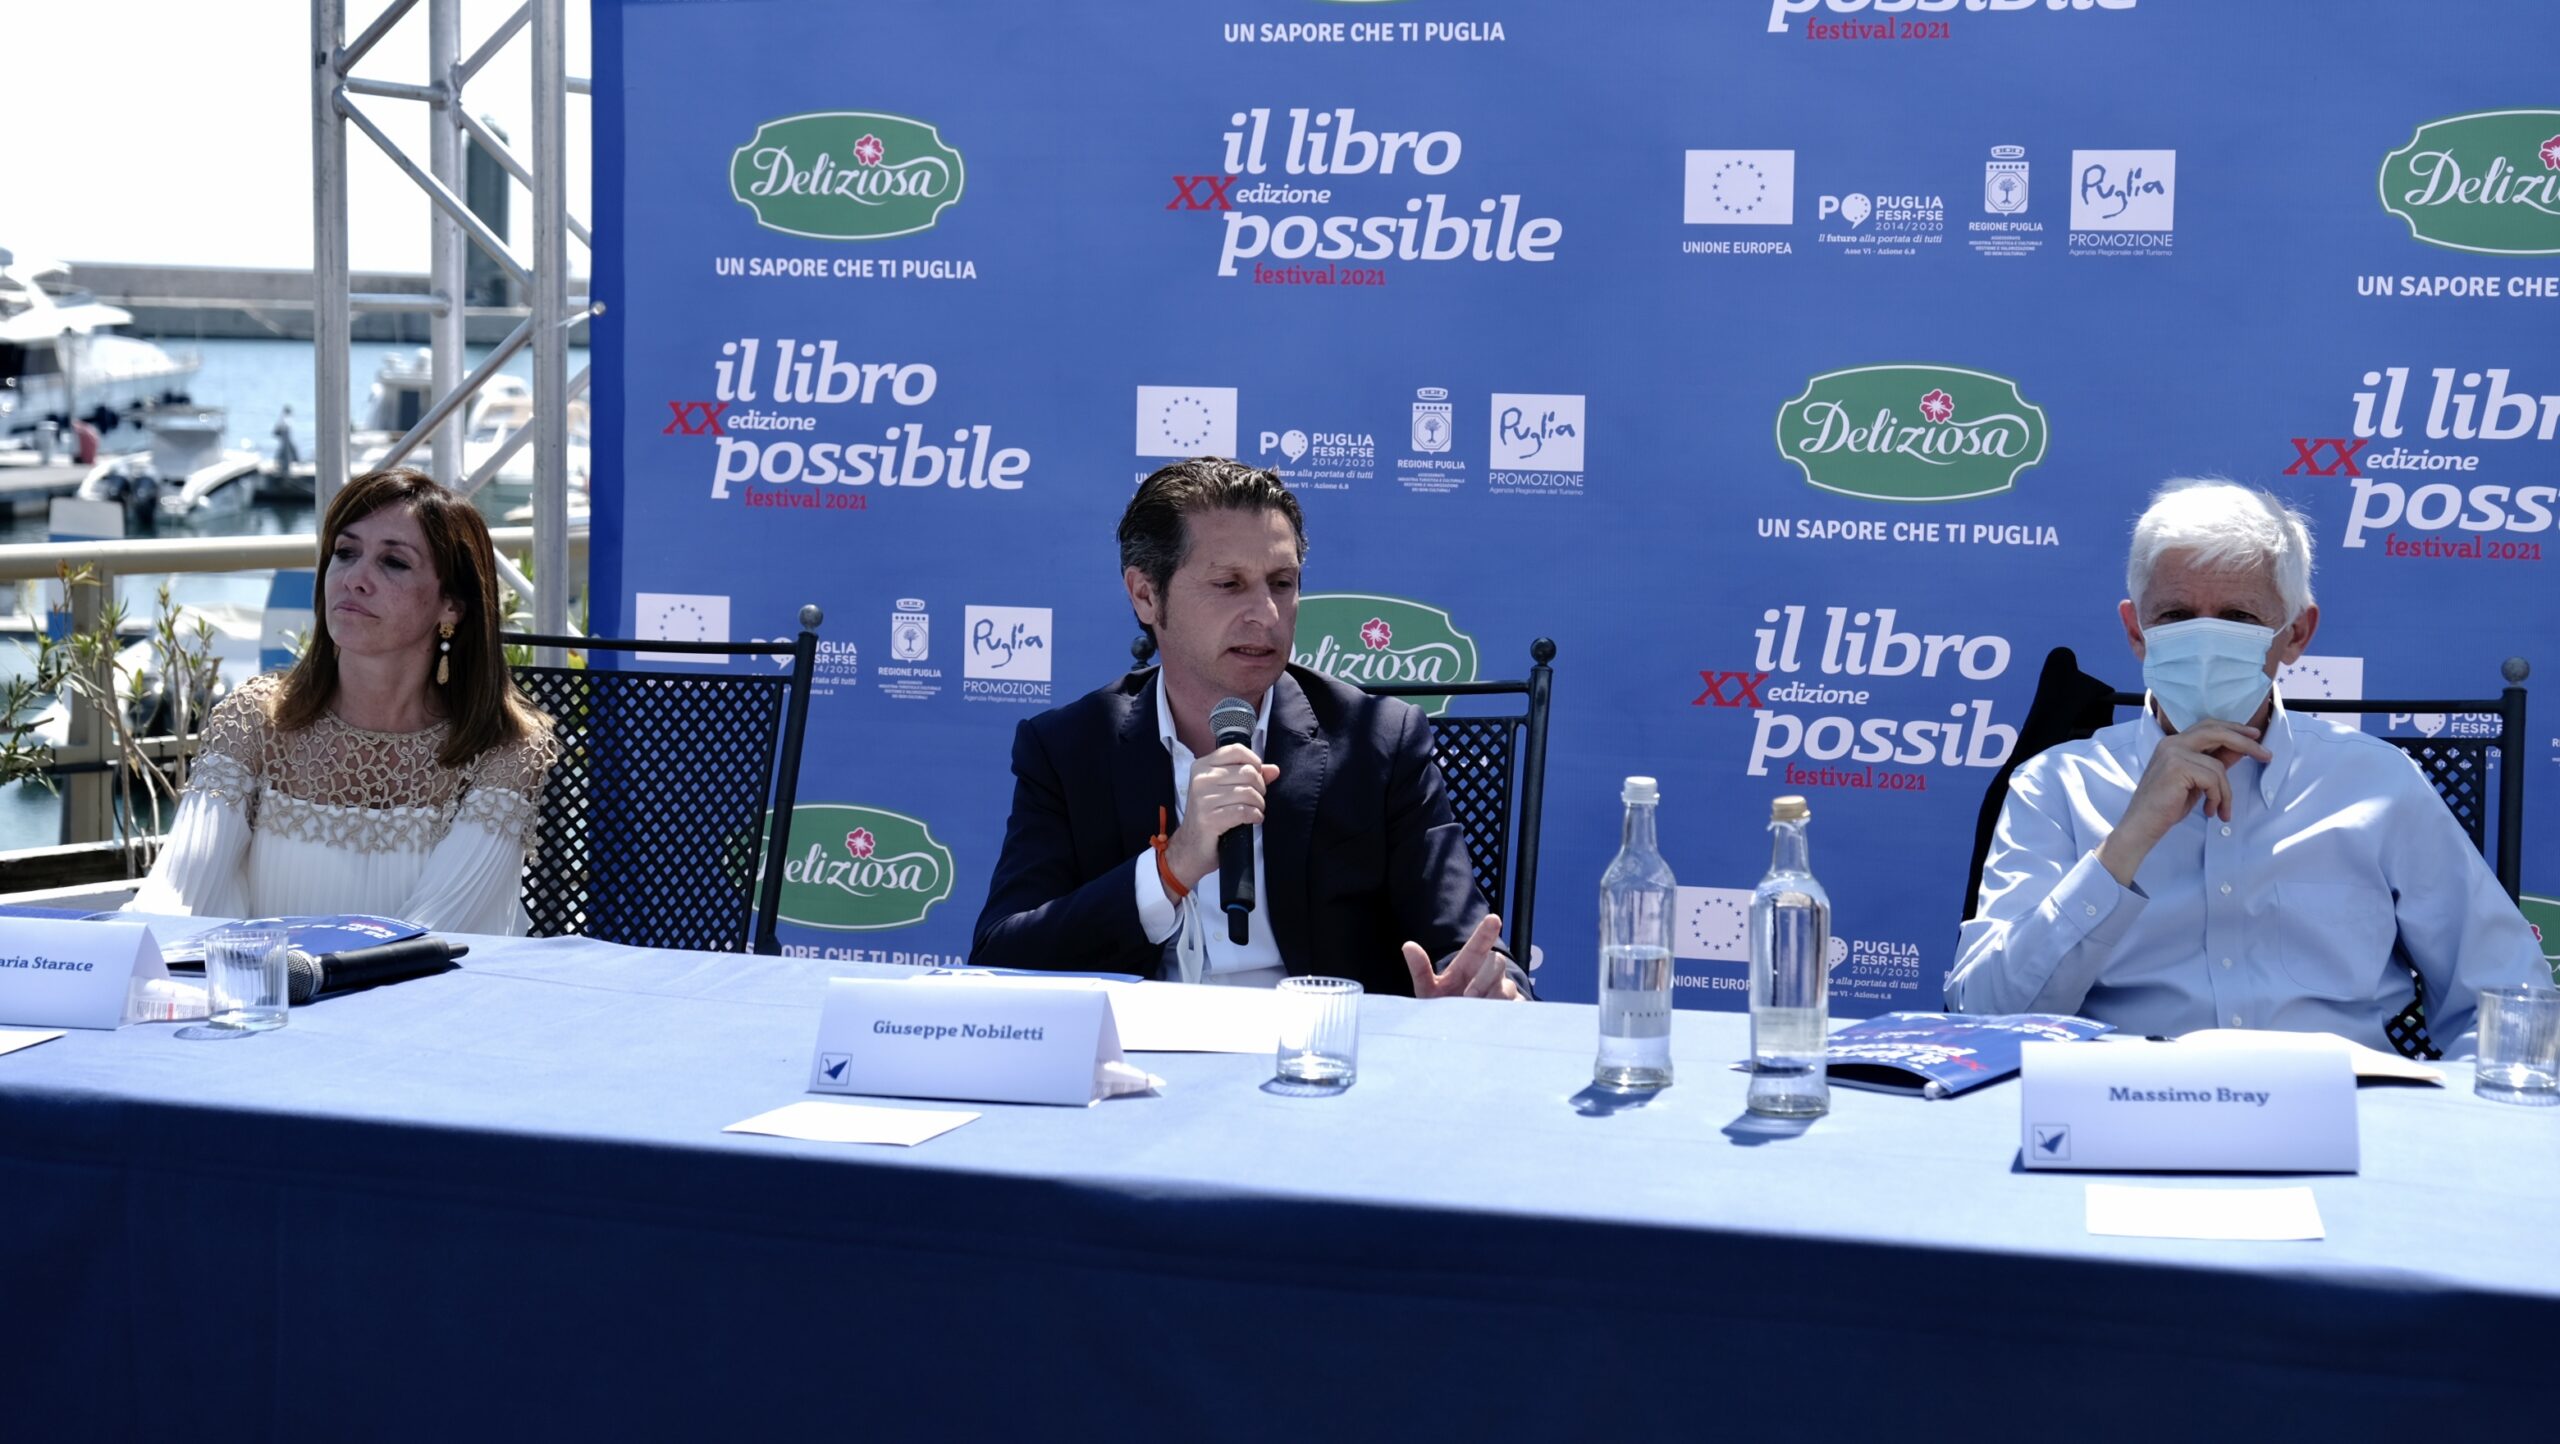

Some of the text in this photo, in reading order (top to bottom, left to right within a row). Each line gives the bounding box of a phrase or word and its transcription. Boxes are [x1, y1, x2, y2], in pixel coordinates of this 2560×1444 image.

[1224, 22, 1505, 42] UN SAPORE CHE TI PUGLIA
[1807, 17, 1950, 39] festival 2021
[1223, 108, 1462, 175] il libro
[751, 146, 949, 205] Deliziosa
[1166, 176, 1331, 210] XX edizione
[1876, 196, 1943, 209] PUGLIA
[2081, 164, 2164, 219] Puglia
[1218, 194, 1562, 276] possibile
[1875, 222, 1943, 231] 2014/2020
[1969, 222, 2043, 231] REGIONE PUGLIA
[1683, 242, 1792, 254] UNIONE EUROPEA
[1827, 234, 1857, 242] futuro
[1859, 234, 1876, 243] alla
[1876, 235, 1910, 245] portata
[1912, 234, 1922, 243] di
[1924, 234, 1942, 243] tutti
[2068, 233, 2173, 246] PROMOZIONE
[716, 257, 977, 279] UN SAPORE CHE TI PUGLIA
[1254, 263, 1385, 286] festival 2021
[2357, 276, 2559, 297] UN SAPORE CHE
[715, 338, 937, 406] il libro
[2353, 367, 2409, 438] il
[662, 401, 816, 436] XX edizione
[1312, 433, 1374, 446] PUGLIA
[1500, 407, 1575, 459] Puglia
[1799, 399, 2029, 465] Deliziosa
[711, 423, 1031, 499] possibile
[1312, 458, 1374, 467] 2014/2020
[1397, 459, 1466, 470] REGIONE PUGLIA
[2282, 438, 2479, 477] XX edizione
[1297, 469, 1312, 478] alla
[1314, 470, 1344, 479] portata
[1346, 469, 1355, 478] di
[1357, 470, 1374, 479] tutti
[1489, 472, 1584, 487] PROMOZIONE
[744, 486, 867, 510] festival 2021
[2343, 478, 2560, 548] poss
[1757, 518, 2059, 546] UN SAPORE CHE TI PUGLIA
[2385, 533, 2541, 560] festival 2021
[973, 618, 1043, 668] Puglia
[1755, 605, 2011, 680] il libro
[1292, 635, 1461, 684] eliziosa
[878, 667, 942, 678] REGIONE PUGLIA
[963, 681, 1051, 696] PROMOZIONE
[1691, 671, 1869, 709] XX edizione
[1785, 762, 1926, 791] festival 2021
[757, 836, 939, 897] eliziosa
[1853, 940, 1919, 956] PUGLIA
[32, 956, 93, 972] Starace
[1852, 966, 1919, 978] 2014/2020
[1836, 977, 1852, 985] alla
[1854, 978, 1886, 988] portata
[1889, 979, 1898, 988] di
[1900, 980, 1918, 990] tutti
[873, 1020, 1044, 1040] Giuseppe Nobiletti
[2109, 1086, 2271, 1108] Massimo Bray
